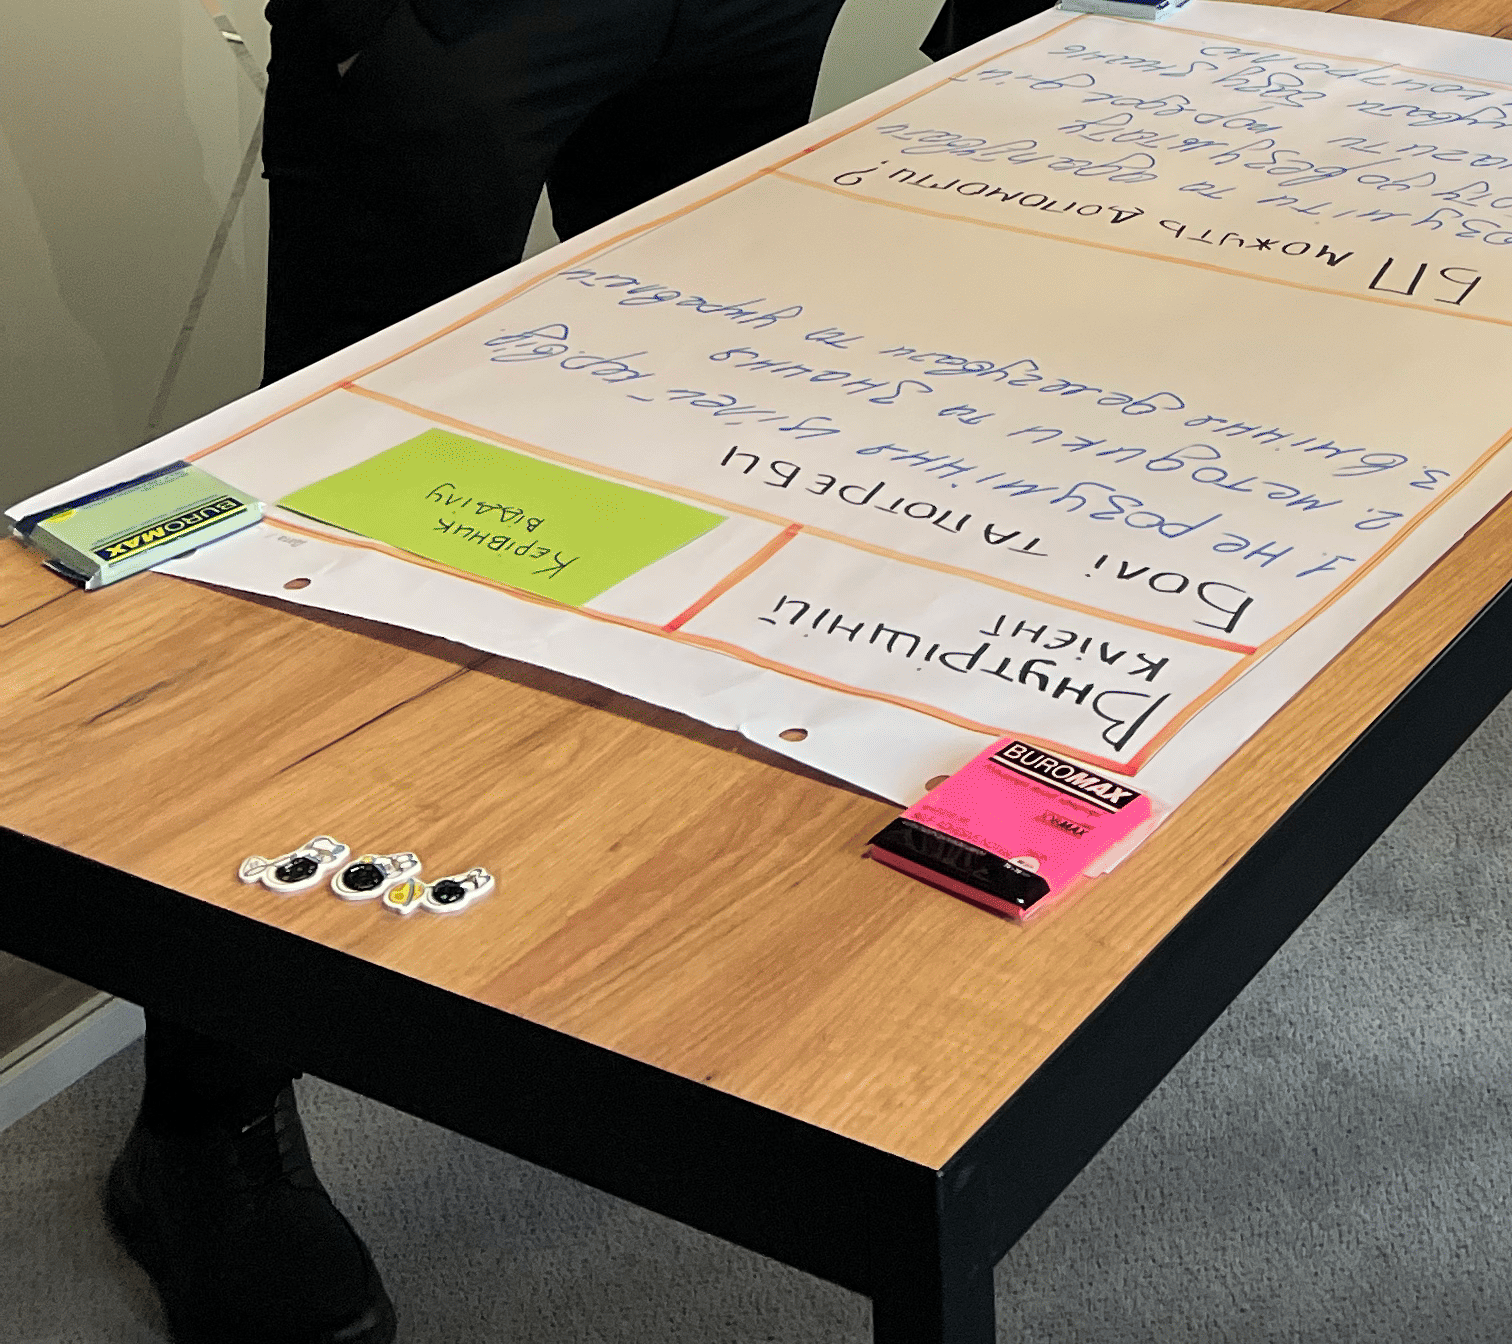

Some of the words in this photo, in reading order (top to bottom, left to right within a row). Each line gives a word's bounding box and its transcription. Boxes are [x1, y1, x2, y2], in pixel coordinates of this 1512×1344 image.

[1178, 181, 1236, 199] та
[1368, 257, 1481, 306] БП
[805, 328, 864, 349] та
[709, 347, 933, 404] знання
[938, 404, 995, 425] та
[1007, 426, 1343, 511] методики
[105, 499, 239, 560] BUROMAX
[1354, 508, 1404, 530] 2.
[1002, 742, 1134, 805] BUROMAX
